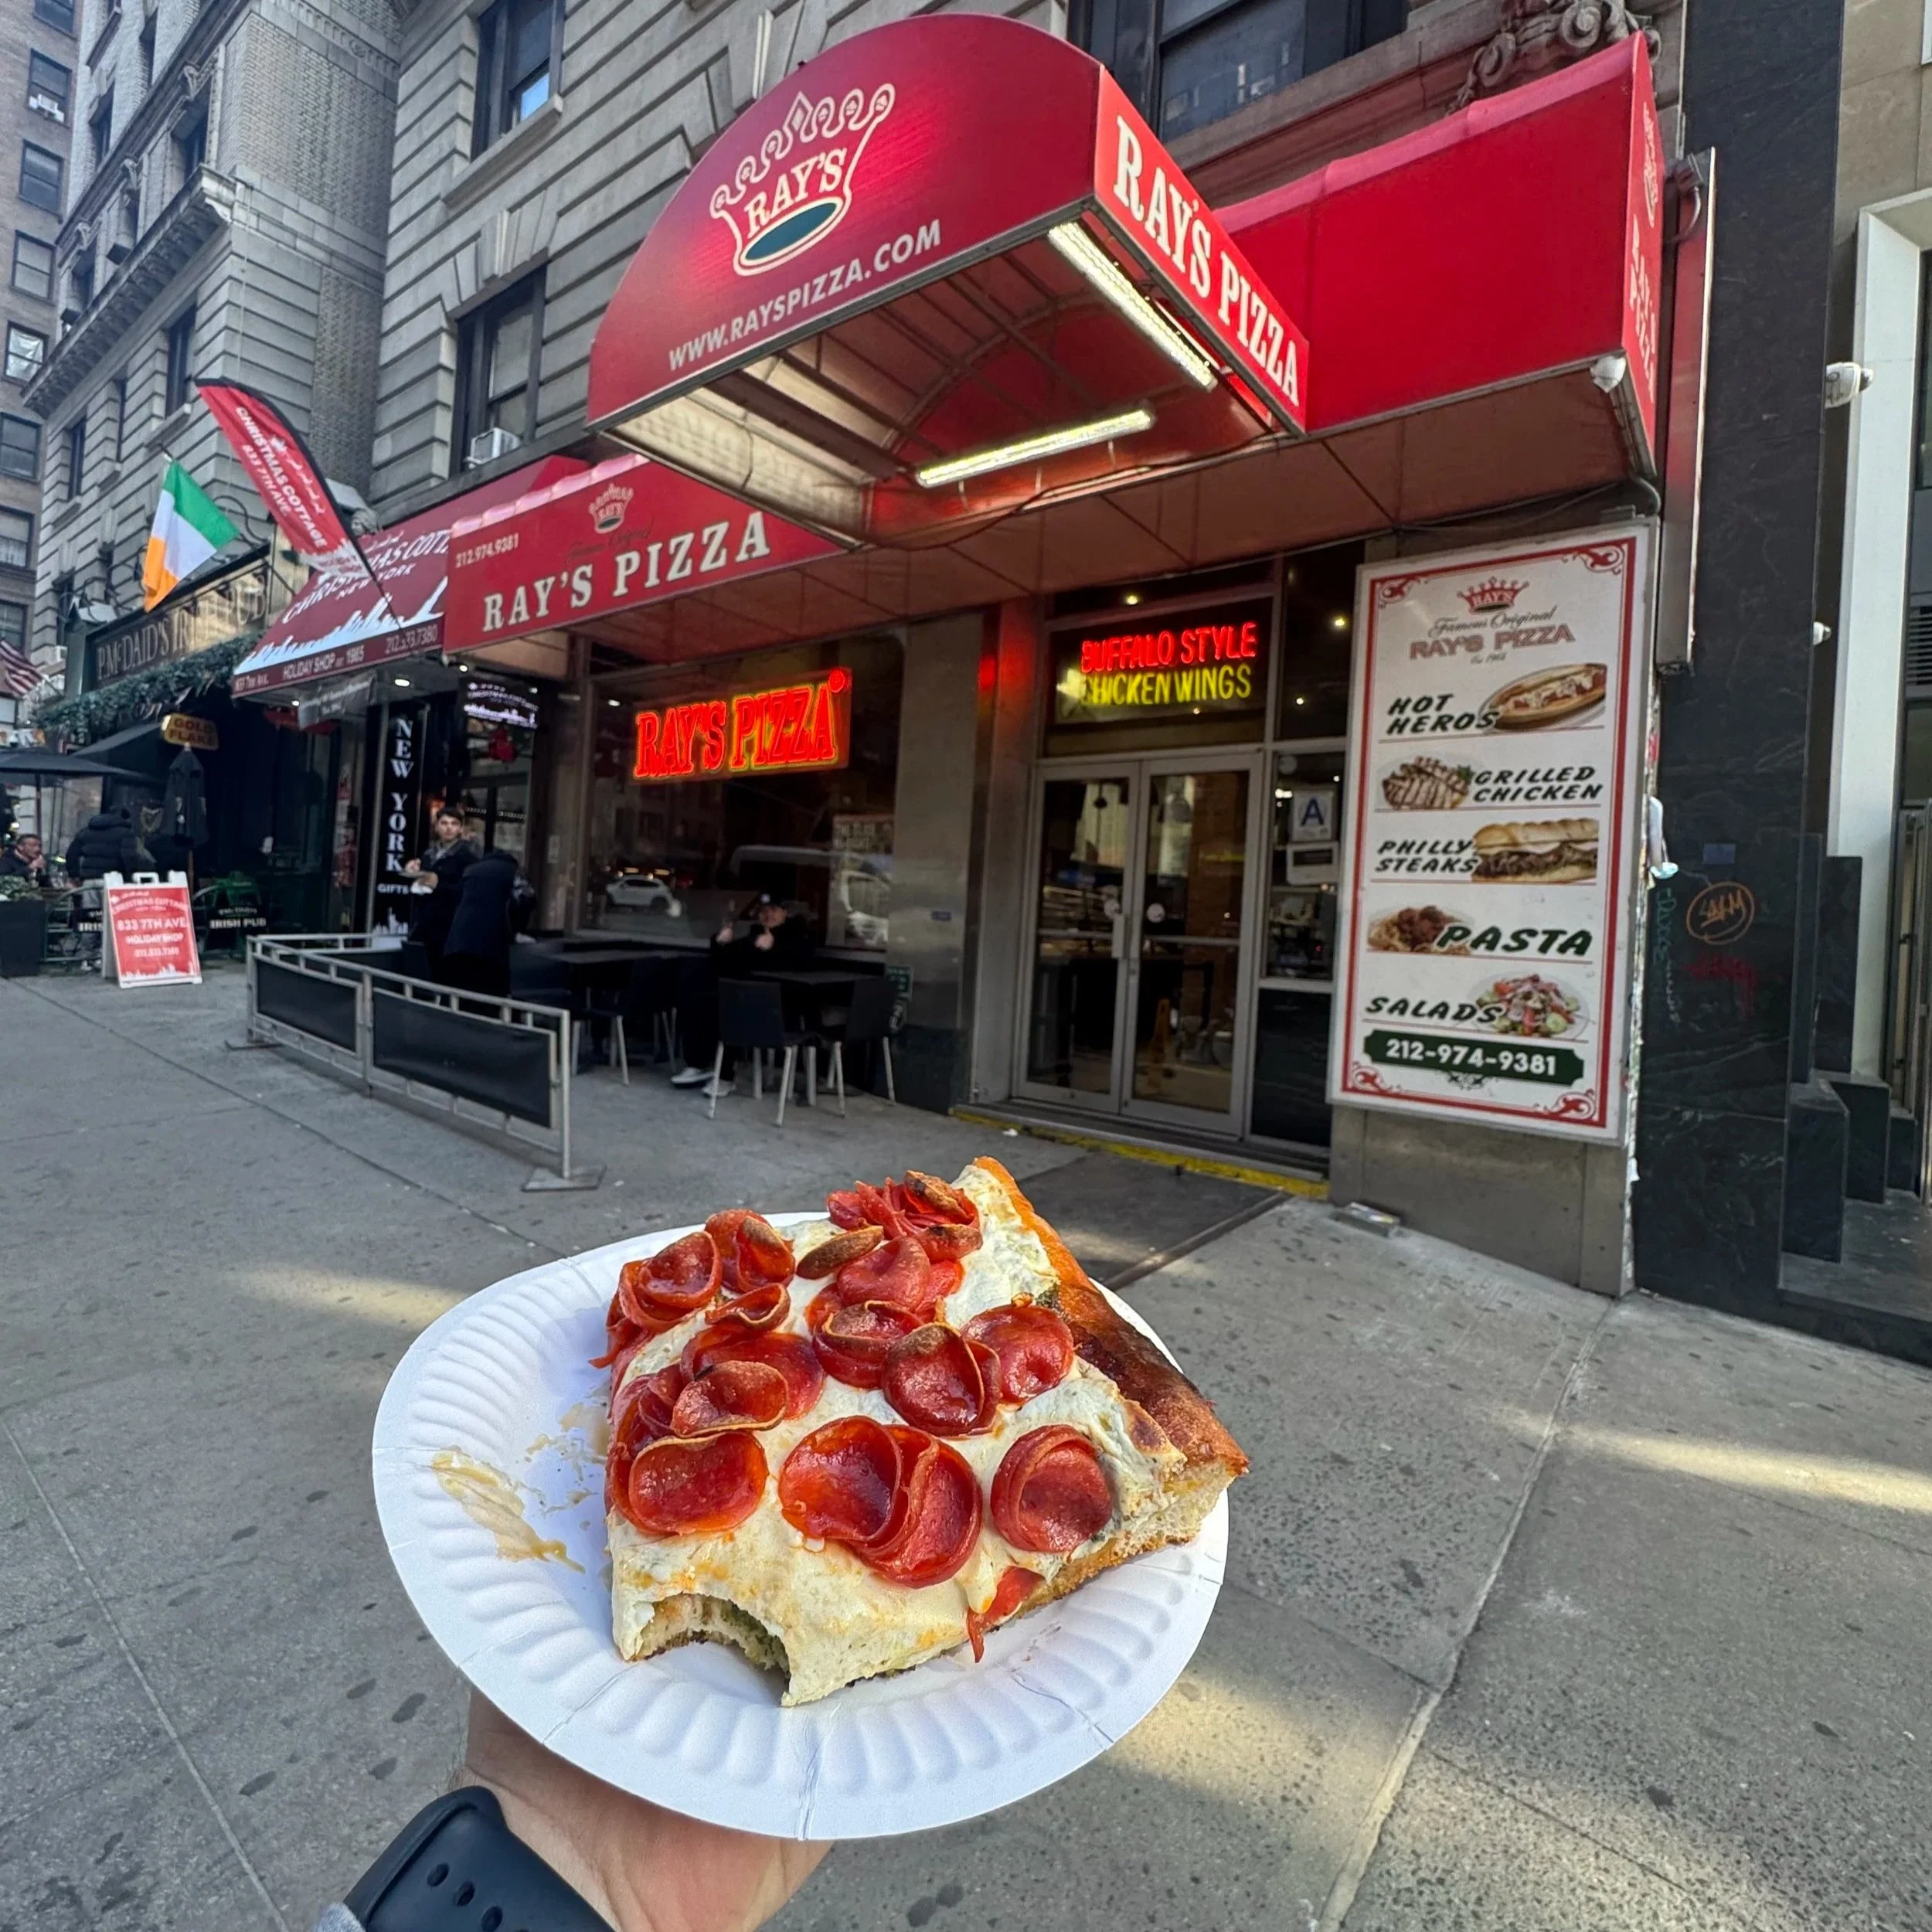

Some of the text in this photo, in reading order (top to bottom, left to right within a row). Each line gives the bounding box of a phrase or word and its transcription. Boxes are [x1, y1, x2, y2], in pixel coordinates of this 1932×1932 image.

[747, 146, 847, 240] RAY'S
[1114, 115, 1300, 407] RAY'S PIZZA
[669, 219, 942, 372] WWW.RAYSPIZZA.COM
[235, 406, 328, 547] CHRISTMAS COTTAGE
[455, 532, 519, 570] 212.974.9381
[482, 511, 770, 633] RAY'S PIZZA
[1490, 604, 1558, 631] Original
[1081, 621, 1257, 673] BUFFALO STYLE
[1410, 634, 1485, 661] RAY'S
[1493, 623, 1576, 651] PIZZA
[283, 658, 314, 681] HOLIDAY
[314, 652, 335, 675] SHOP
[1174, 663, 1252, 703] WINGS
[1387, 694, 1454, 716] HOT
[634, 683, 838, 778] RAY'S PIZZA
[1387, 712, 1499, 735] HEROS
[389, 718, 414, 779] NEW
[1475, 767, 1595, 784] GRILLED
[1474, 784, 1602, 803] CHICKEN
[1300, 798, 1324, 826] A
[386, 792, 408, 872] YORK
[1377, 839, 1473, 855] PHILLY
[1375, 856, 1479, 874] STEAKS
[141, 918, 163, 930] 7TH
[209, 917, 267, 929] IRISH PUB
[126, 933, 162, 944] HOLIDAY
[1437, 926, 1593, 956] PASTA
[1366, 997, 1503, 1022] SALADS
[1386, 1039, 1556, 1075] 212-974-9381
